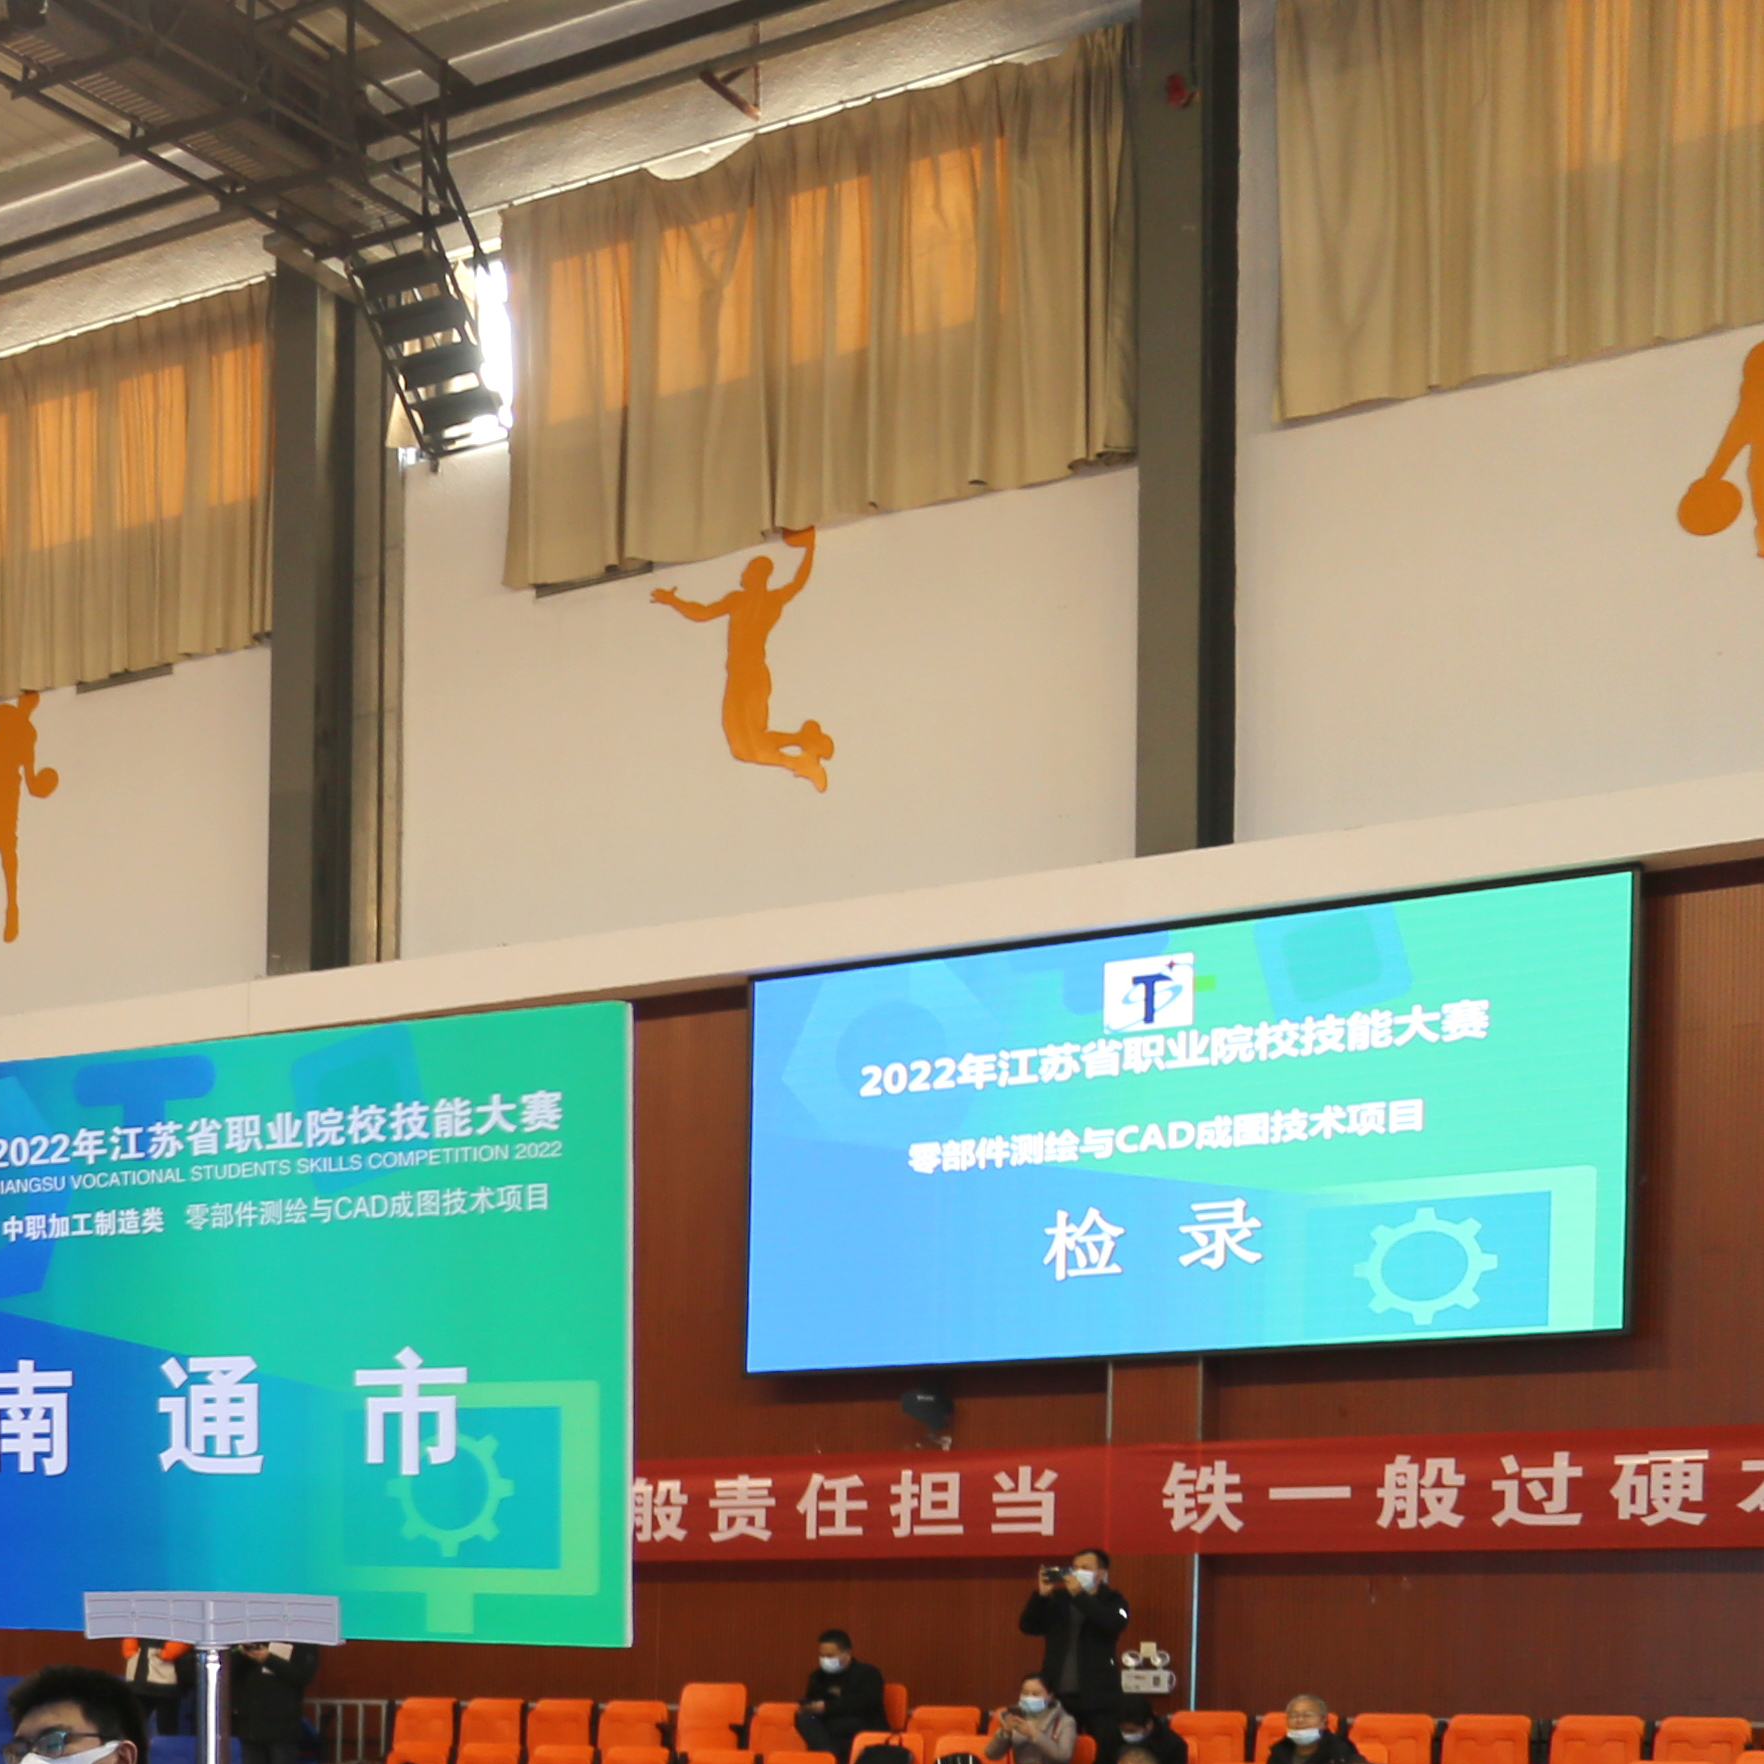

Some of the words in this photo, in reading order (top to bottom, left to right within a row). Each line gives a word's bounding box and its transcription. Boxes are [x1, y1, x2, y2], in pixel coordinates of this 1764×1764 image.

[858, 999, 1491, 1099] 2022年江苏省职业院校技能大赛
[71, 1167, 185, 1190] VOCATIONAL
[190, 1158, 291, 1182] STUDENTS
[297, 1154, 362, 1175] SKILLS
[368, 1144, 510, 1170] COMPETITION
[514, 1141, 563, 1160] 2022
[907, 1098, 1425, 1175] 零部件测绘与CAD成图技术项目
[2, 1206, 165, 1242] 中职加工制造类
[185, 1183, 549, 1230] 零部件测绘与CAD成图技术项目
[1042, 1197, 1265, 1283] 检录
